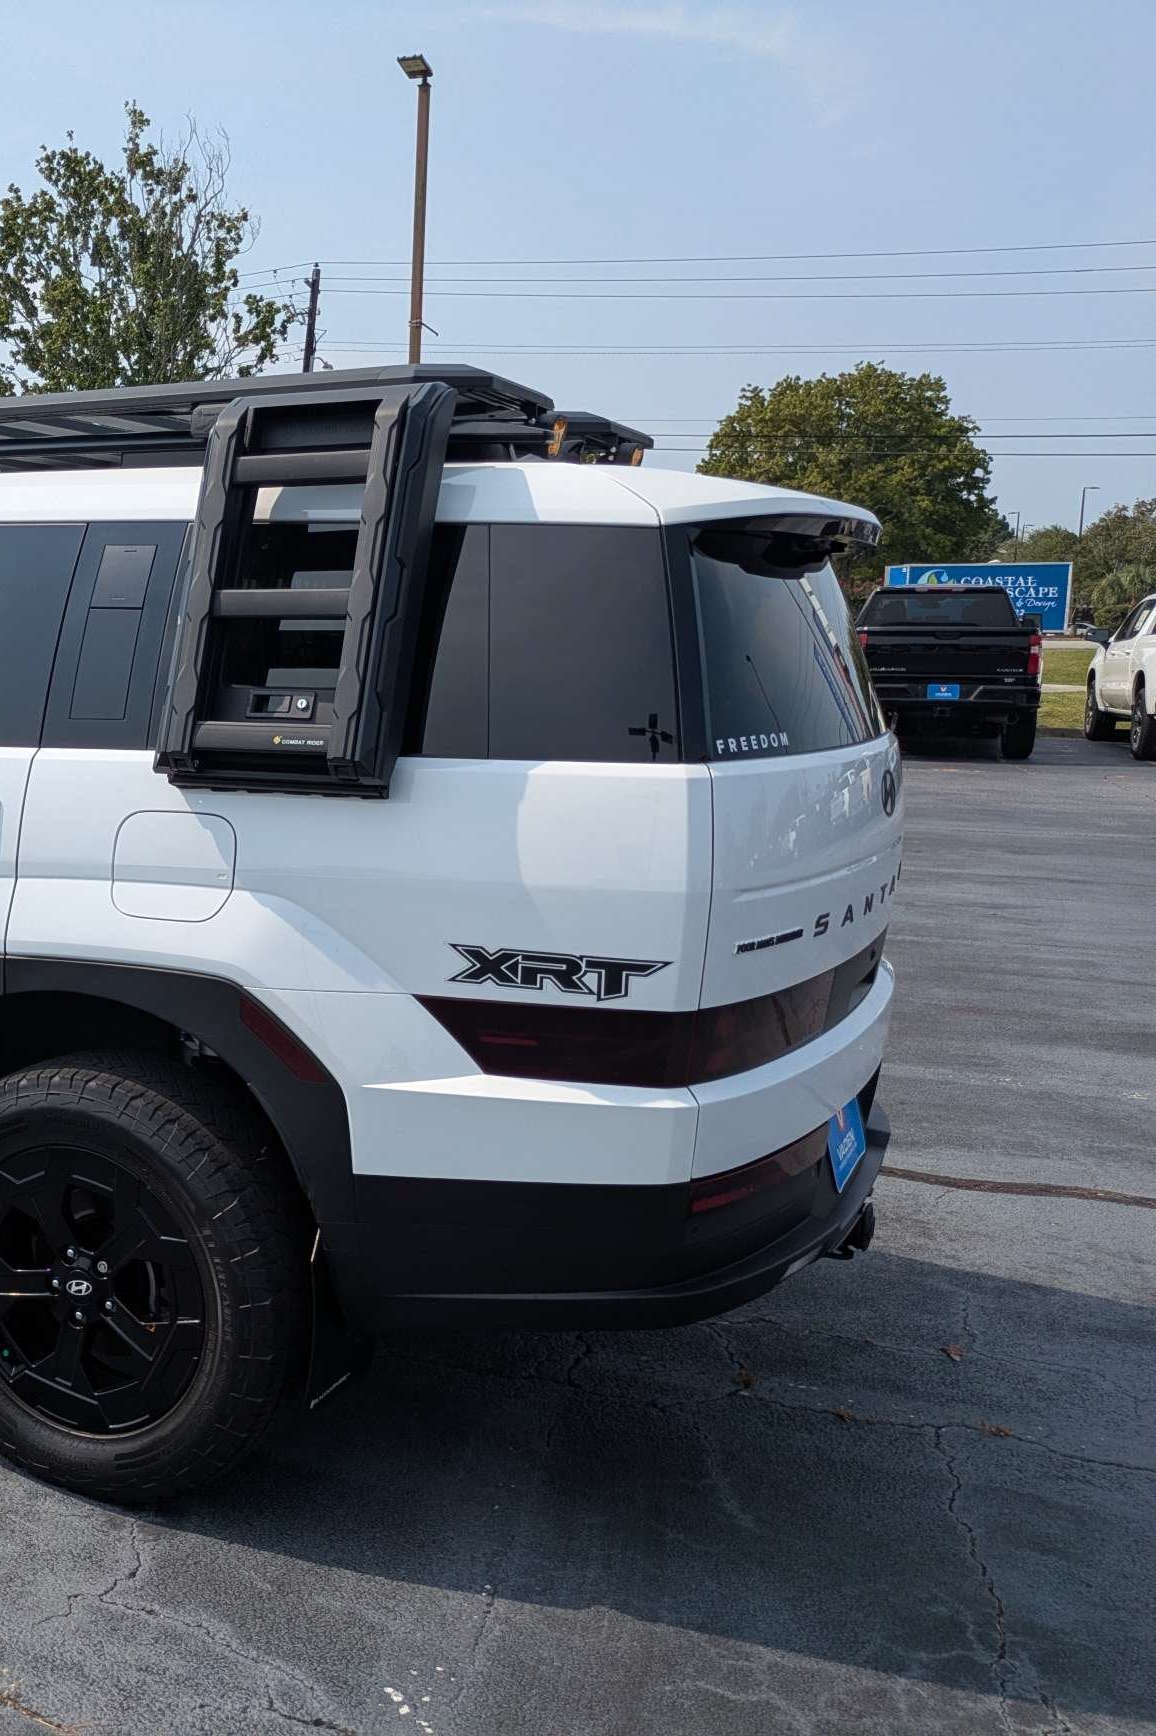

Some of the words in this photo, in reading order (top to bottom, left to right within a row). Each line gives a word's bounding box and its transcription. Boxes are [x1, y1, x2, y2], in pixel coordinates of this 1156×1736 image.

[960, 576, 1037, 587] COASTAL
[1007, 587, 1059, 598] SCAPE
[716, 732, 789, 754] FREEDOM
[813, 875, 896, 938] SANTA
[447, 943, 675, 1002] XRT
